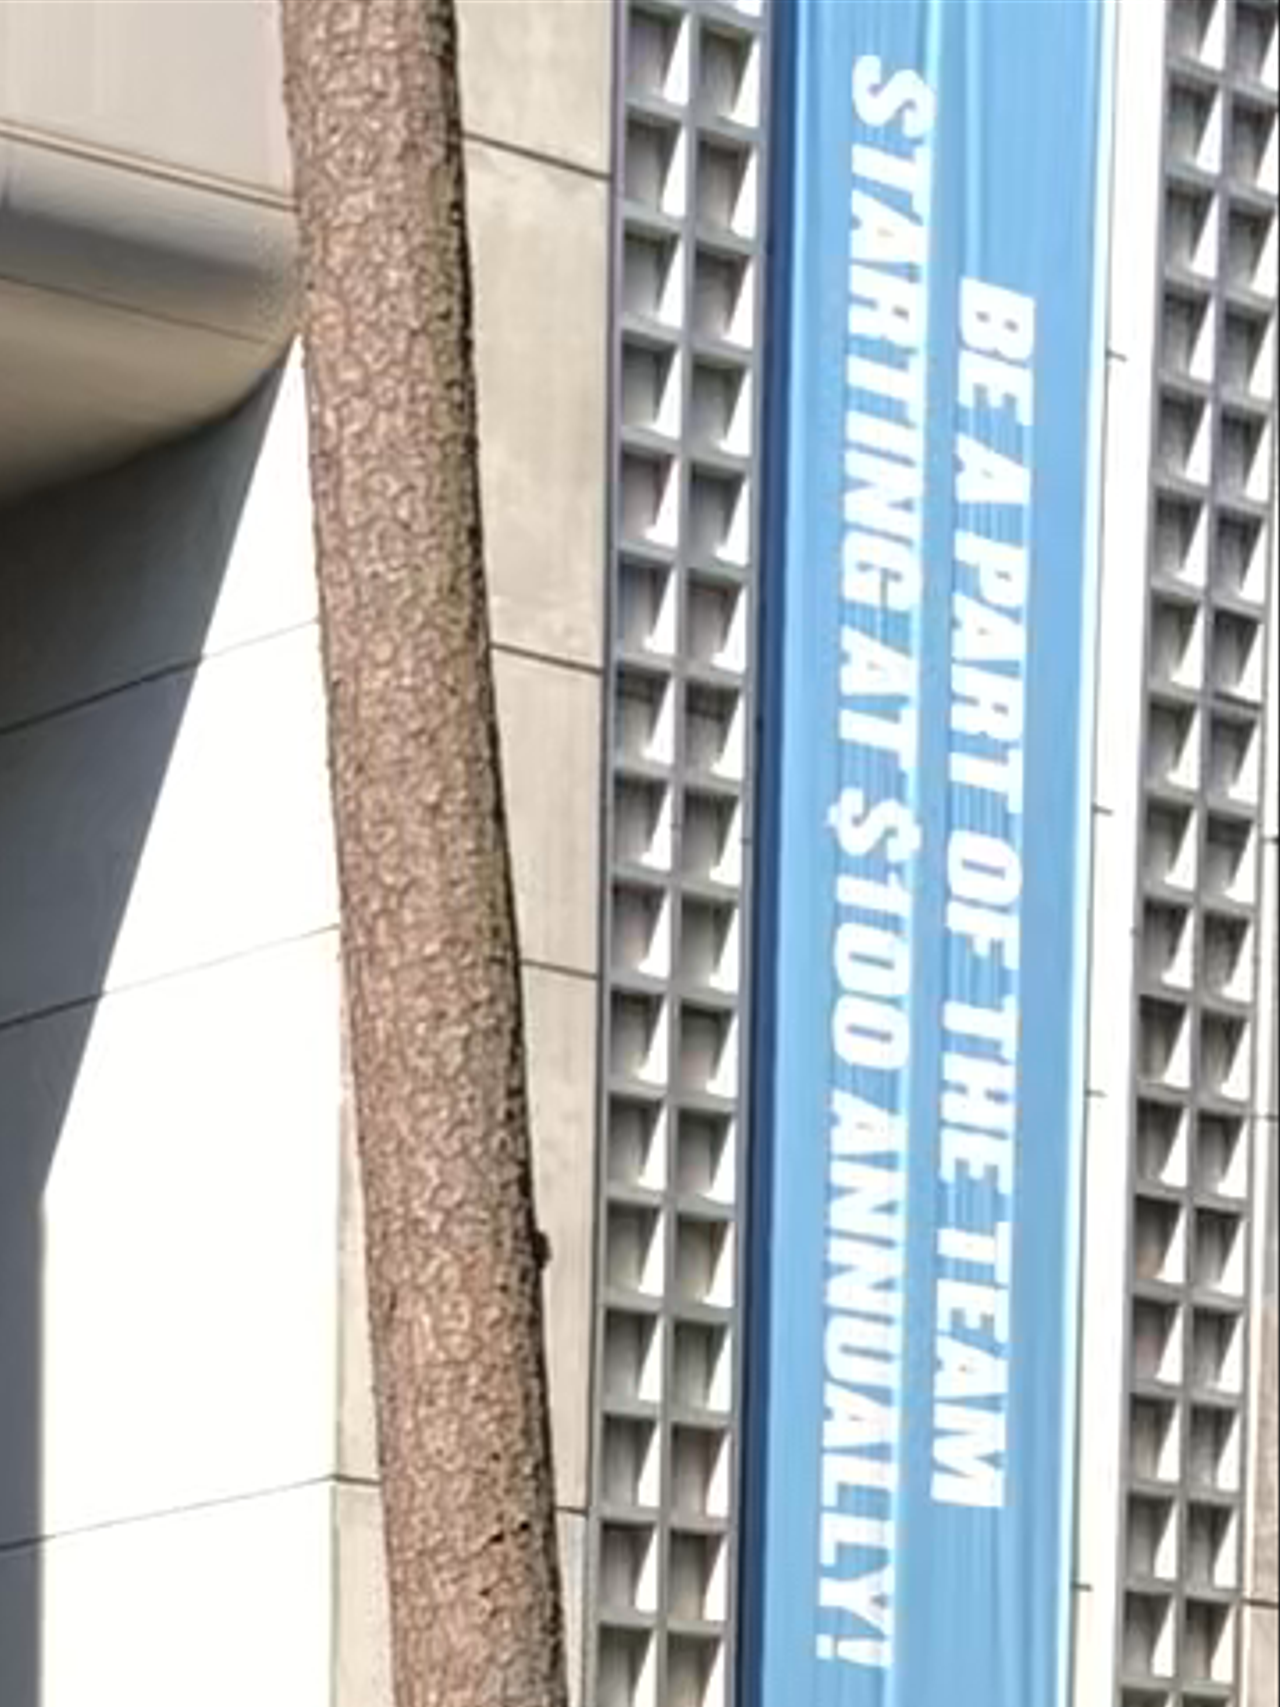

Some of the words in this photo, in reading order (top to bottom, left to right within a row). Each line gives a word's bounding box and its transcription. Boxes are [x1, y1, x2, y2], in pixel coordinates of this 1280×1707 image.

[840, 53, 936, 606] STARTING
[958, 276, 1035, 426] BE
[953, 432, 1031, 508] A
[838, 625, 920, 773] AT
[947, 529, 1030, 814] PART
[828, 787, 922, 1074] $100
[943, 826, 1024, 969] OF
[939, 993, 1021, 1199] THE
[814, 1089, 910, 1669] ANNUALLY!
[929, 1219, 1013, 1511] TEAM
